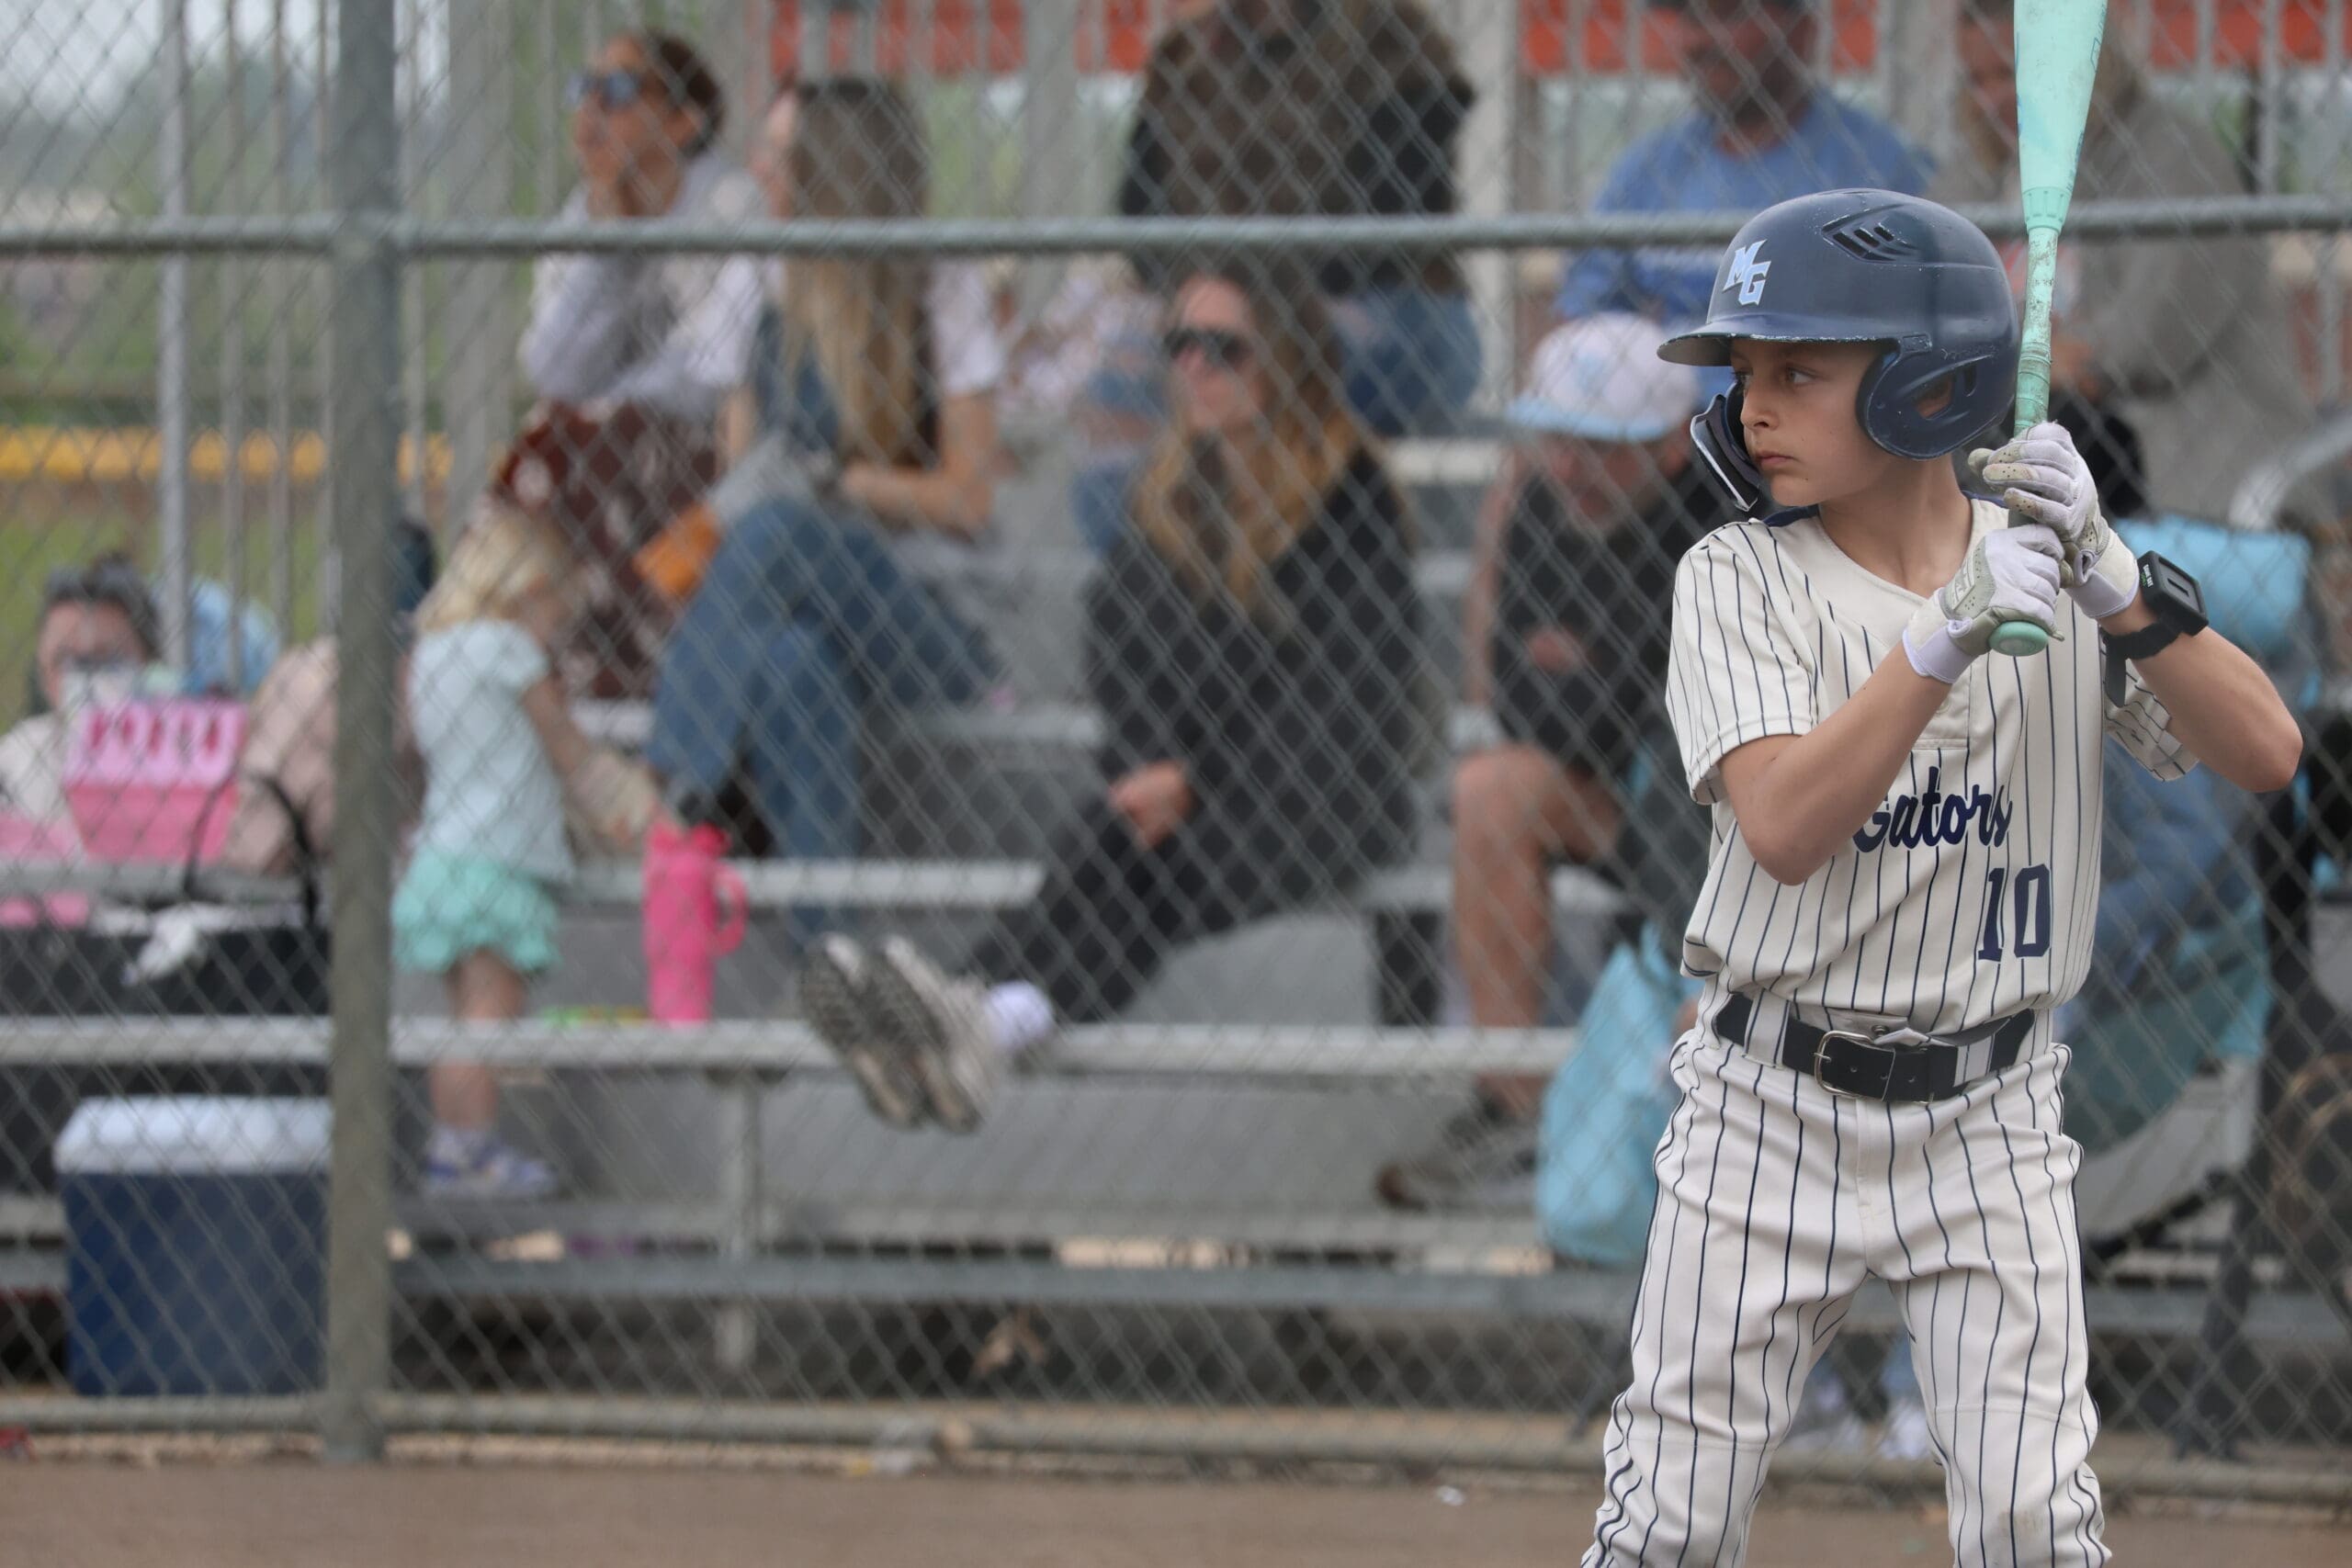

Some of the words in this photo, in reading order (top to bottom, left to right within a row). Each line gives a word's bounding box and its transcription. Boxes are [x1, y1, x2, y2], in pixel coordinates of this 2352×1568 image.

[1722, 239, 1771, 306] MG
[1852, 766, 2013, 853] Gators
[1978, 863, 2051, 962] 10
